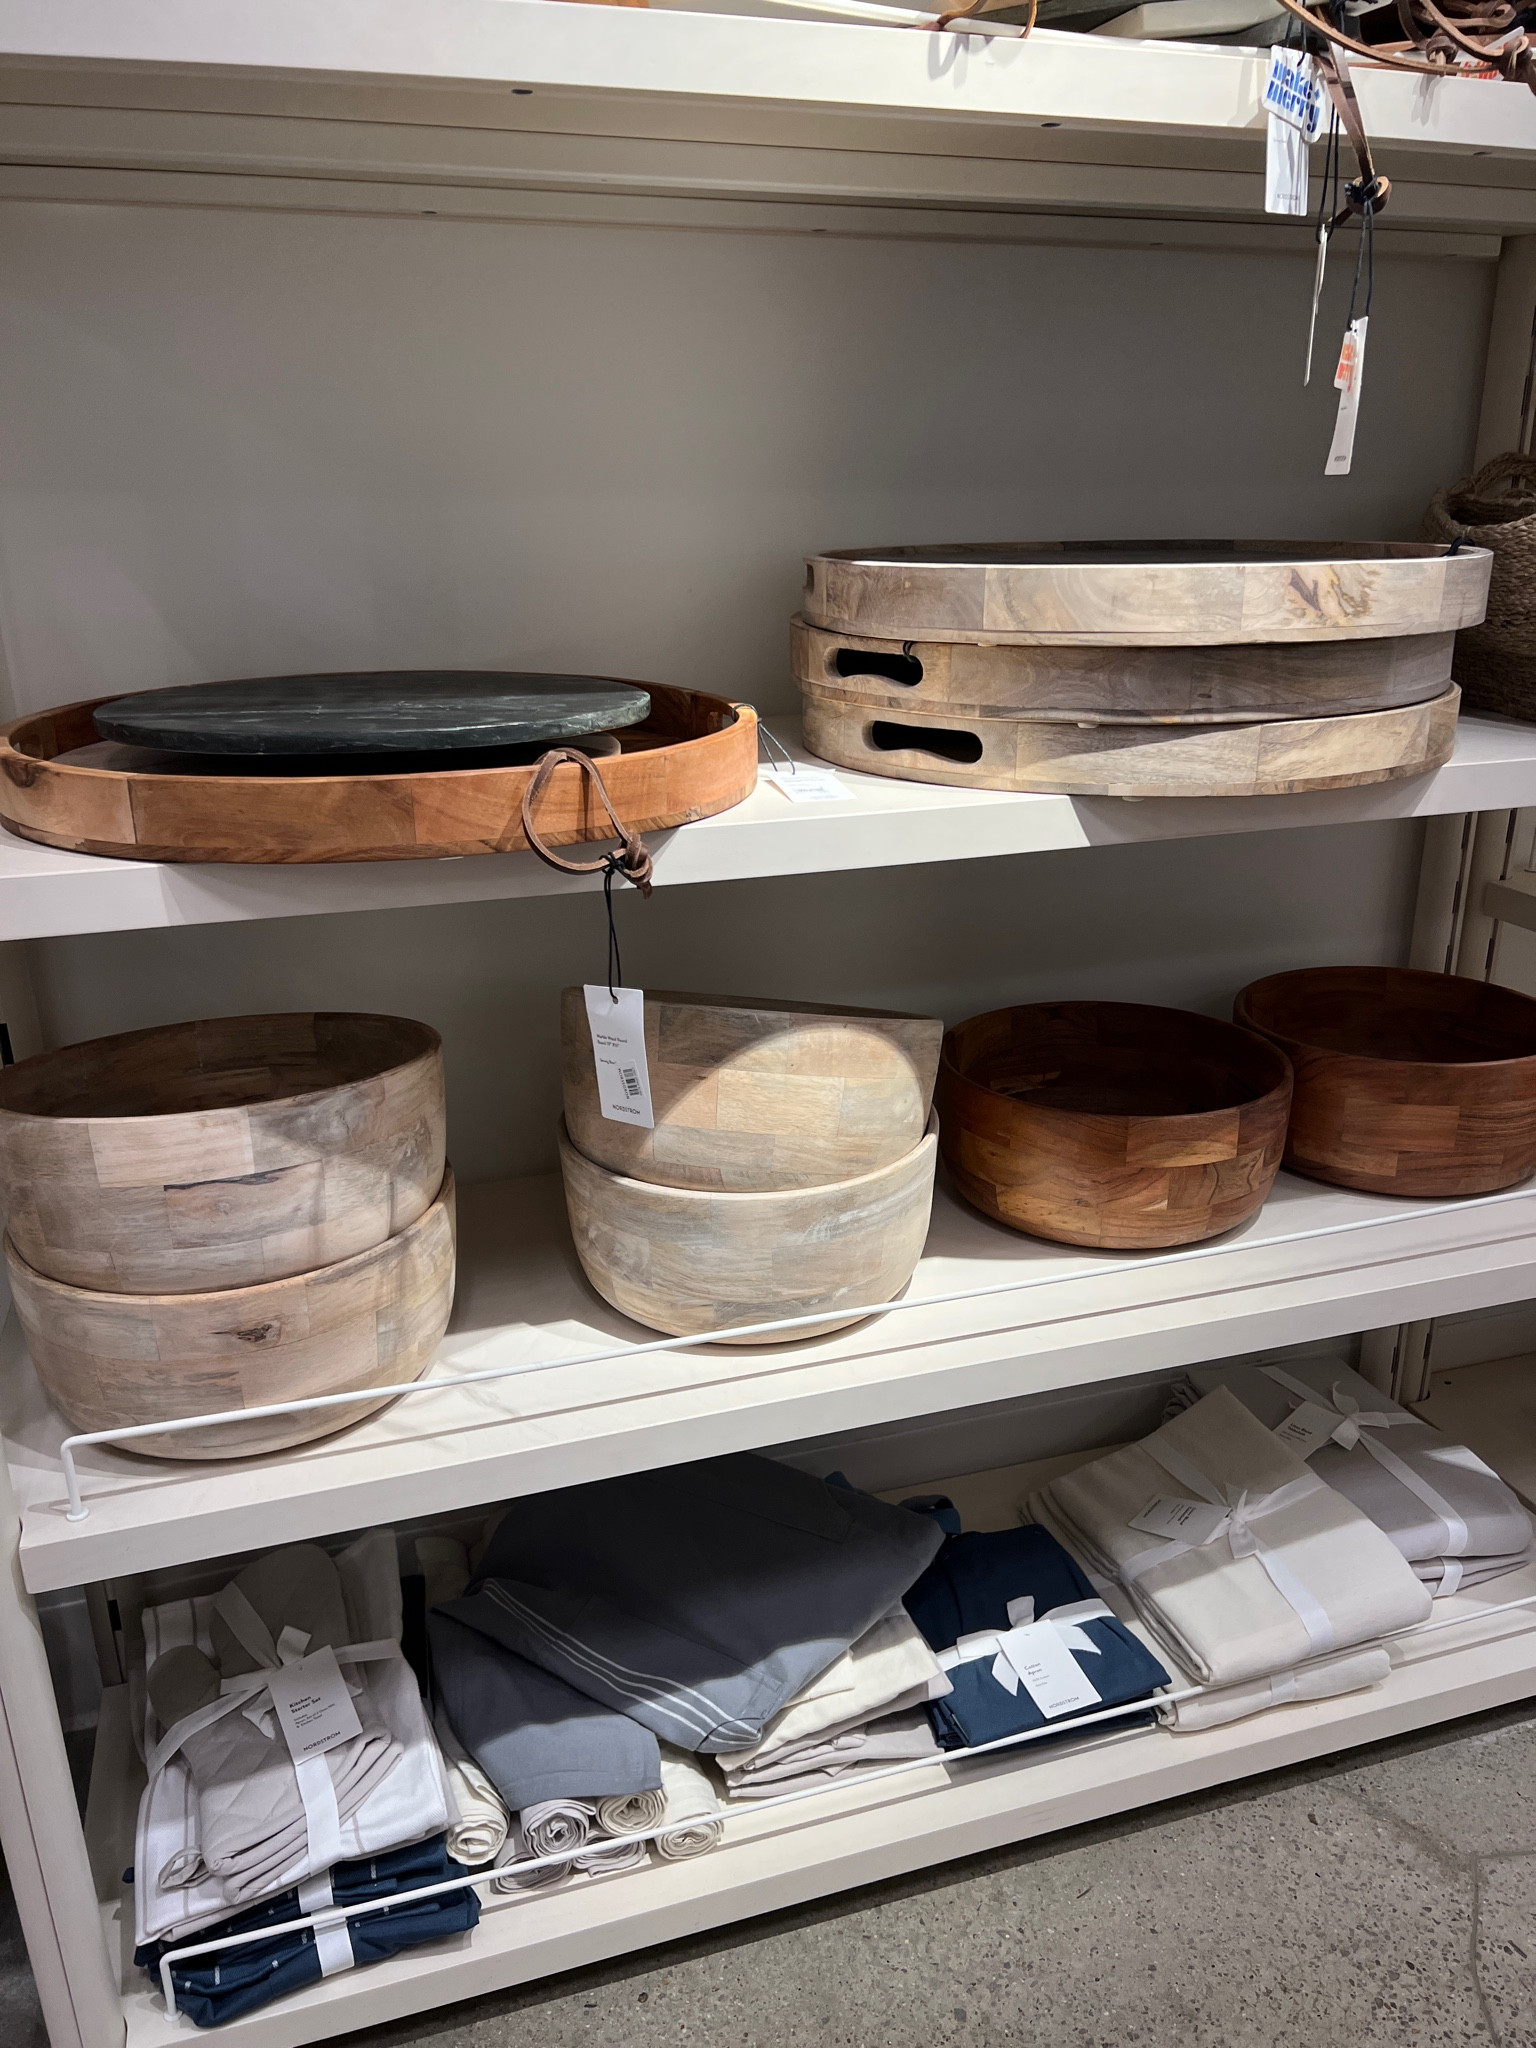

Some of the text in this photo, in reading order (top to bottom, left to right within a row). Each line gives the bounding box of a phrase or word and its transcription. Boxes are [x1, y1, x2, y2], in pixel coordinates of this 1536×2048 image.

[612, 1104, 641, 1115] NORDSTROM
[289, 1696, 312, 1709] Kitchen
[291, 1702, 311, 1713] Starter
[1049, 1696, 1080, 1709] NORDSTROM
[303, 1731, 342, 1752] NORDSTROM
